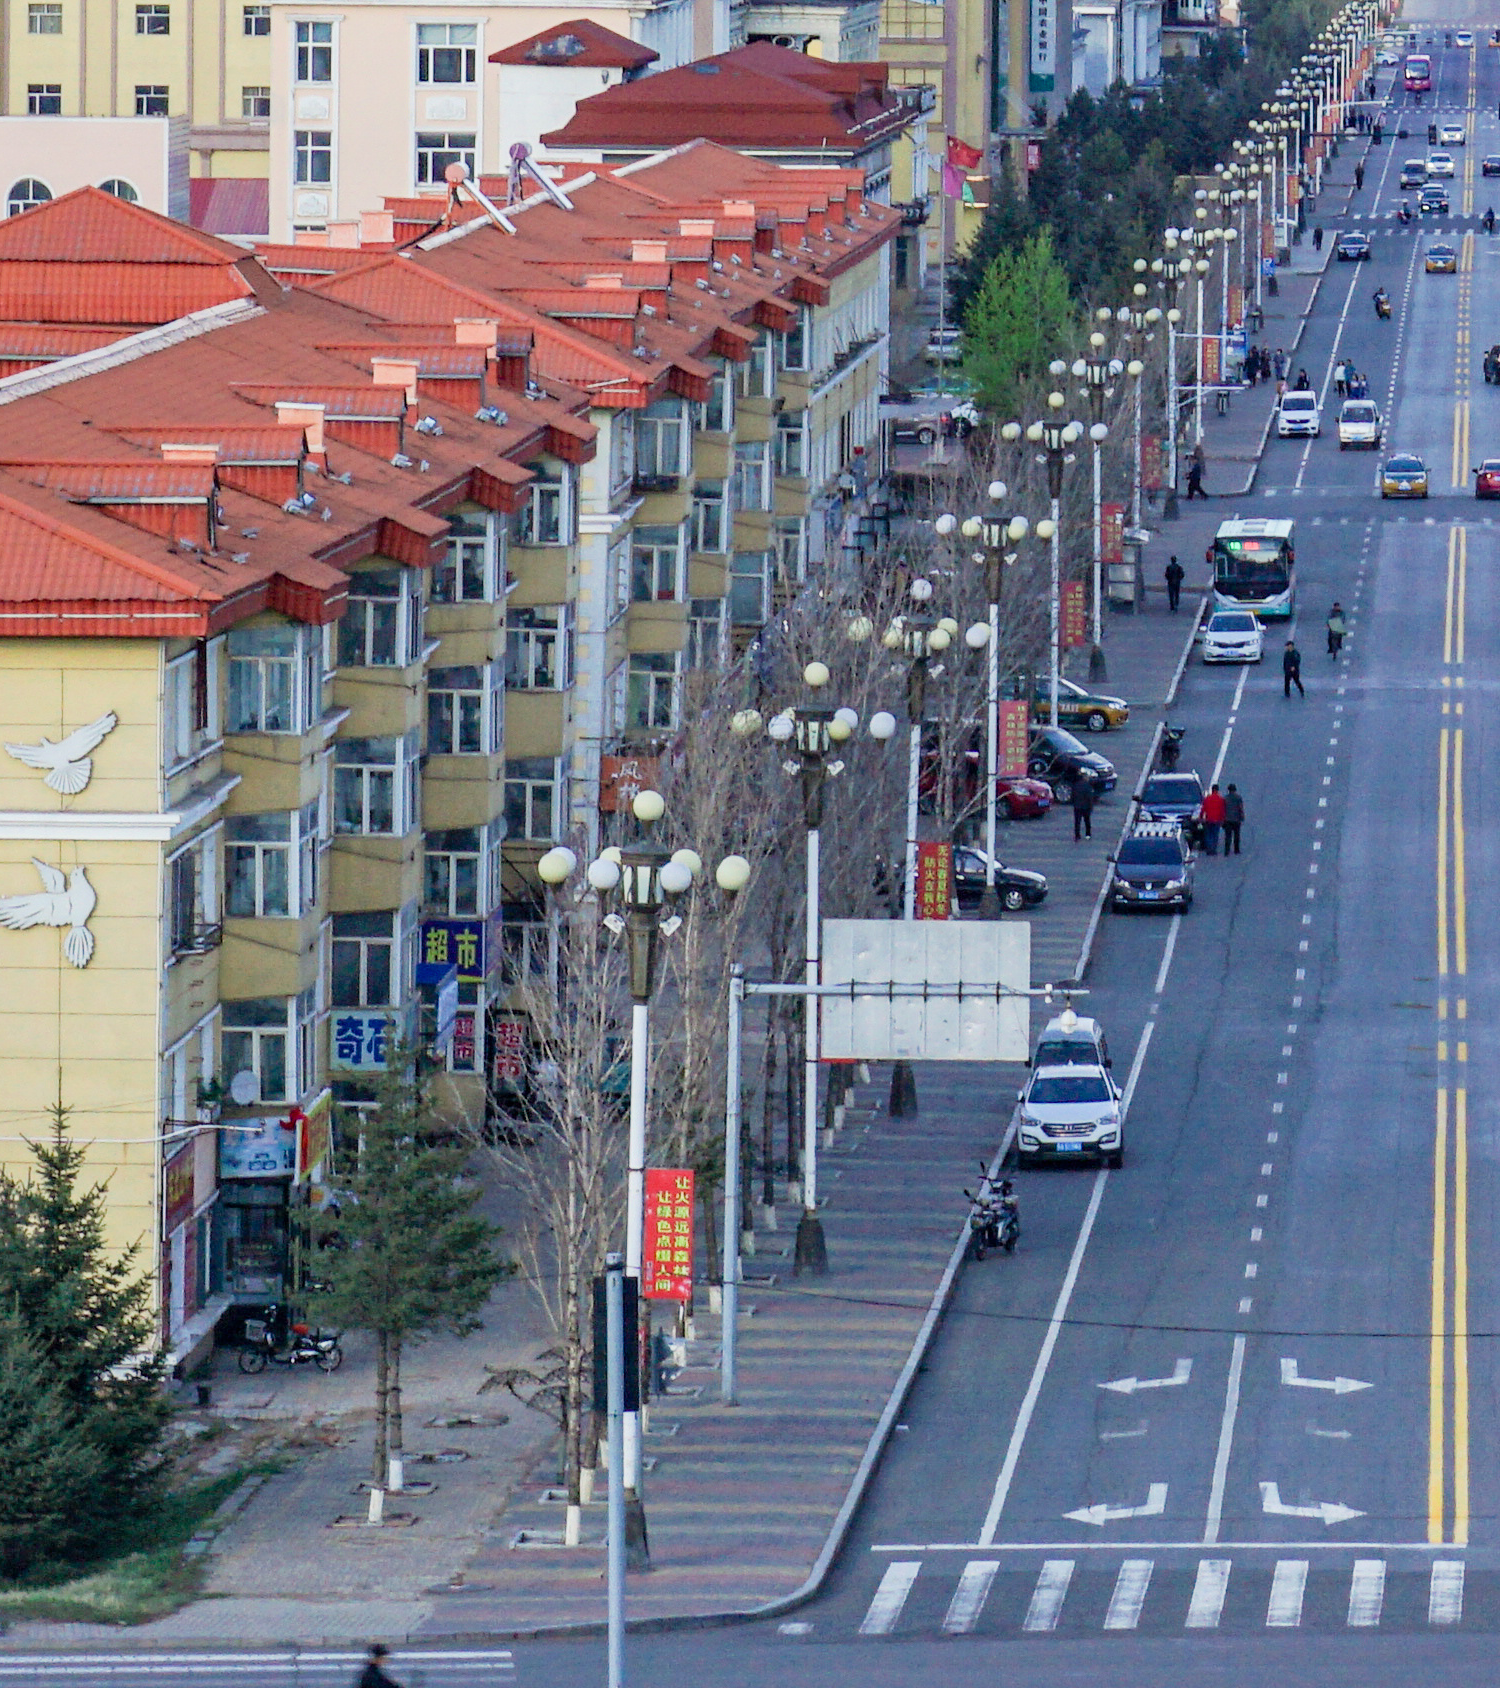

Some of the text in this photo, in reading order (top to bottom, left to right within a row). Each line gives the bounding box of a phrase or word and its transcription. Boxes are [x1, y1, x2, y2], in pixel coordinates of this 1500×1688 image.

[426, 928, 478, 969] 超市
[655, 1191, 672, 1292] 让绿色点缀人间
[674, 1176, 690, 1277] 让火源远离森林
